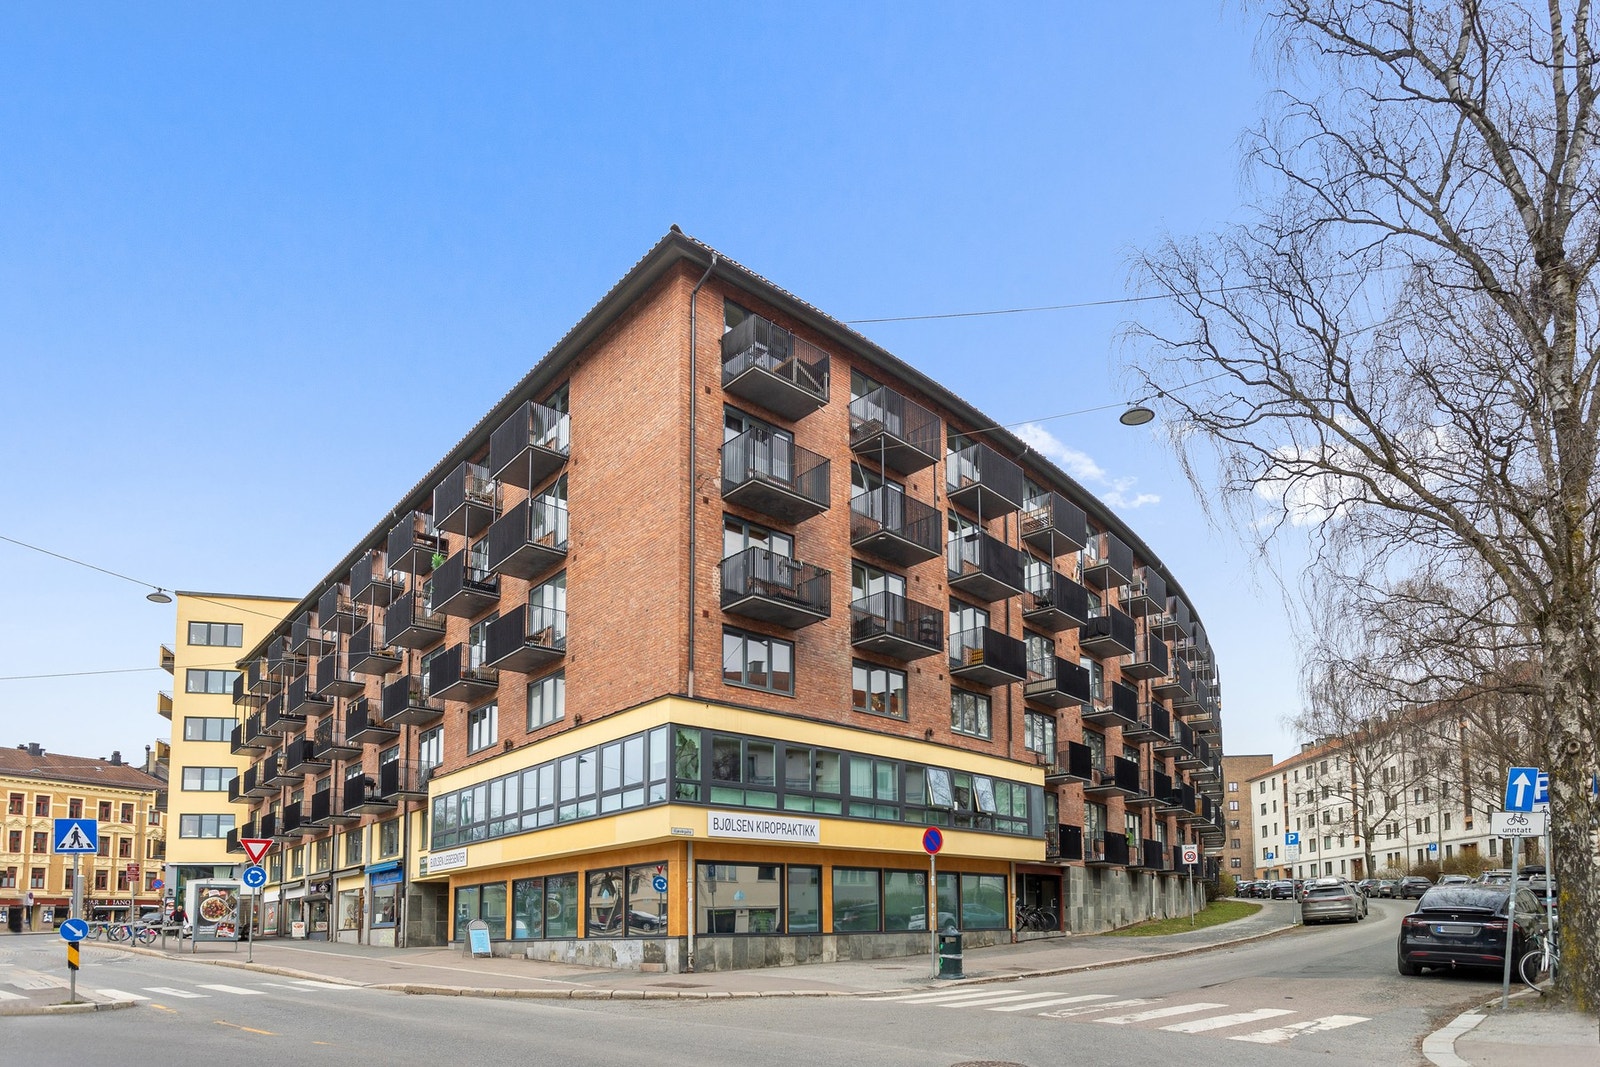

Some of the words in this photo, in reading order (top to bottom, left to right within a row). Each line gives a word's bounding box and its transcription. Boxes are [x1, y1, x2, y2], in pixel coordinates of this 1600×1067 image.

[713, 817, 754, 832] BJØLSEN
[756, 821, 816, 837] KIROPRAKTIKK
[1288, 834, 1296, 844] P
